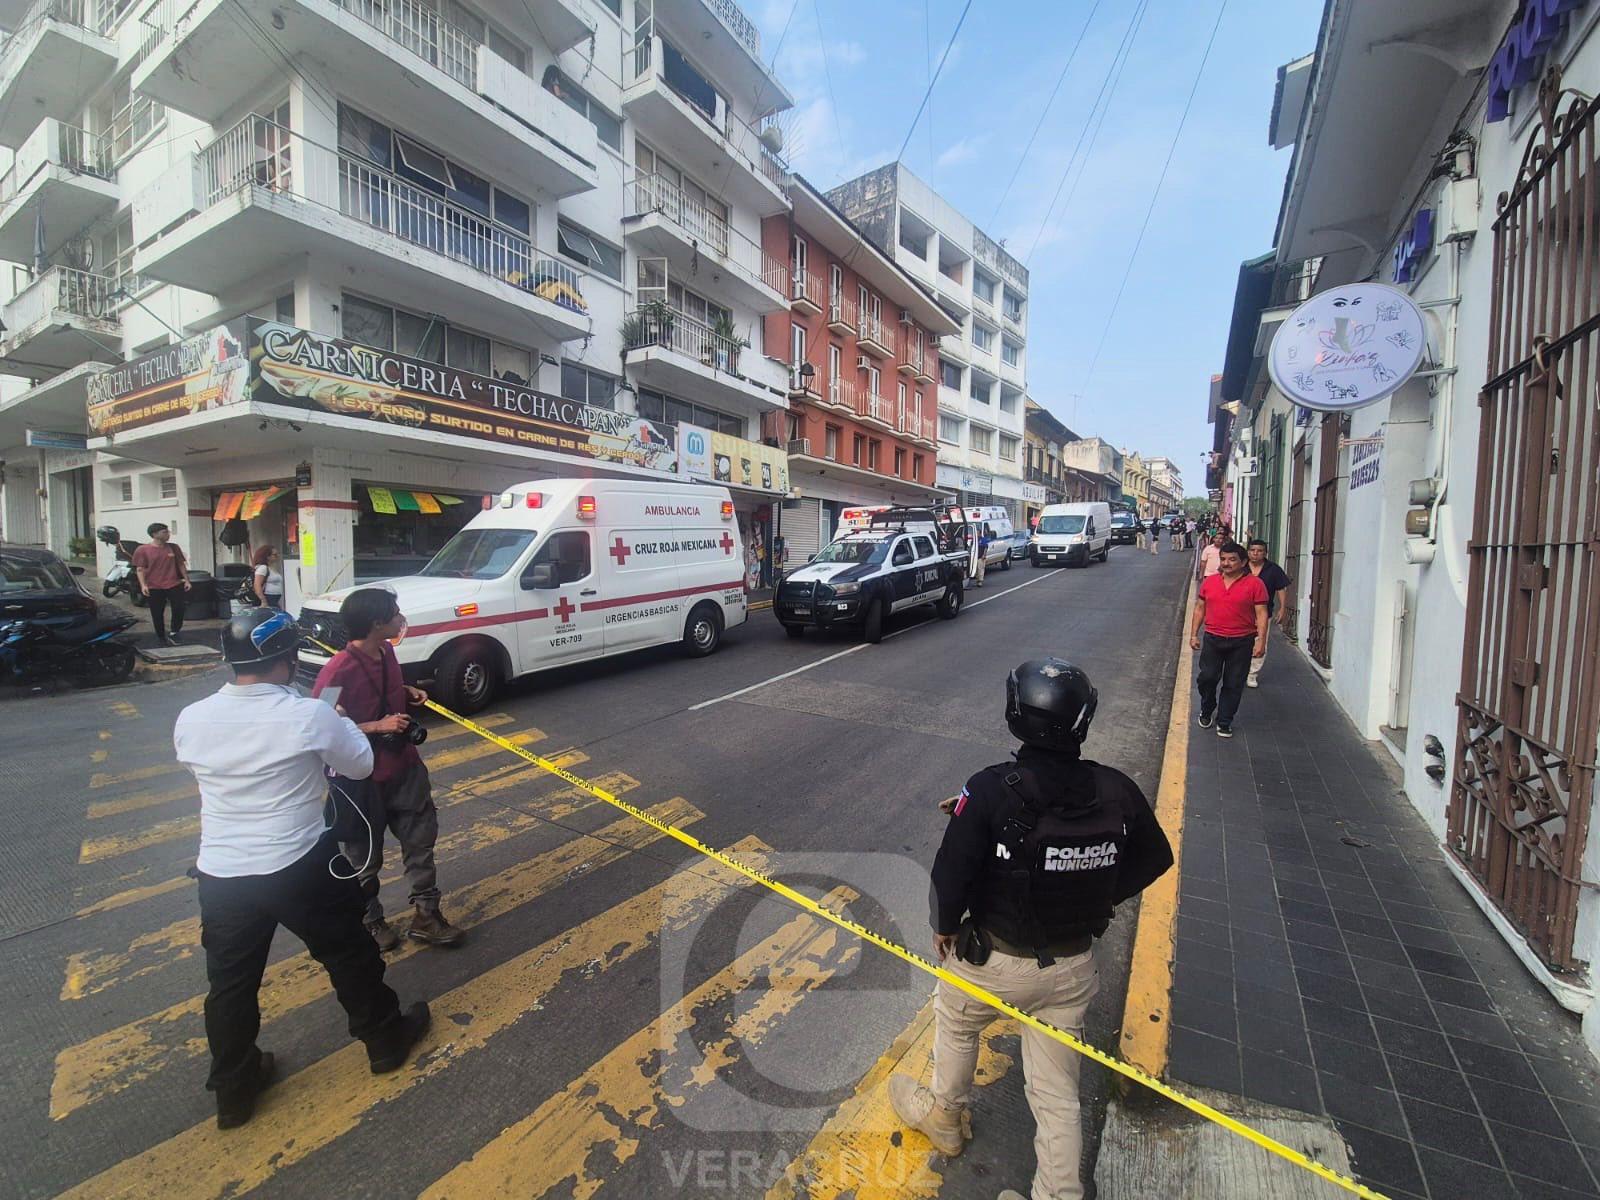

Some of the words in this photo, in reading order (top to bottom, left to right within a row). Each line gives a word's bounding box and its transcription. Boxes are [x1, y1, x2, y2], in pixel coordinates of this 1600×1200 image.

[263, 329, 467, 400] CARNICERIA
[343, 398, 426, 421] EXTENSO
[430, 414, 493, 433] SURTIDO
[496, 425, 514, 438] EN
[517, 430, 558, 446] CARNE
[560, 438, 576, 450] DE
[578, 442, 597, 454] RES
[645, 506, 700, 516] AMBULANCIA
[635, 543, 658, 555] CRUZ
[659, 541, 680, 553] ROJA
[681, 539, 717, 551] MEXICANA
[605, 609, 649, 624] URGENCIAS
[649, 604, 679, 616] BASICAS
[550, 634, 582, 648] VER-709
[1046, 841, 1118, 860] POLICÍA
[1044, 855, 1117, 872] MUNICIPAL
